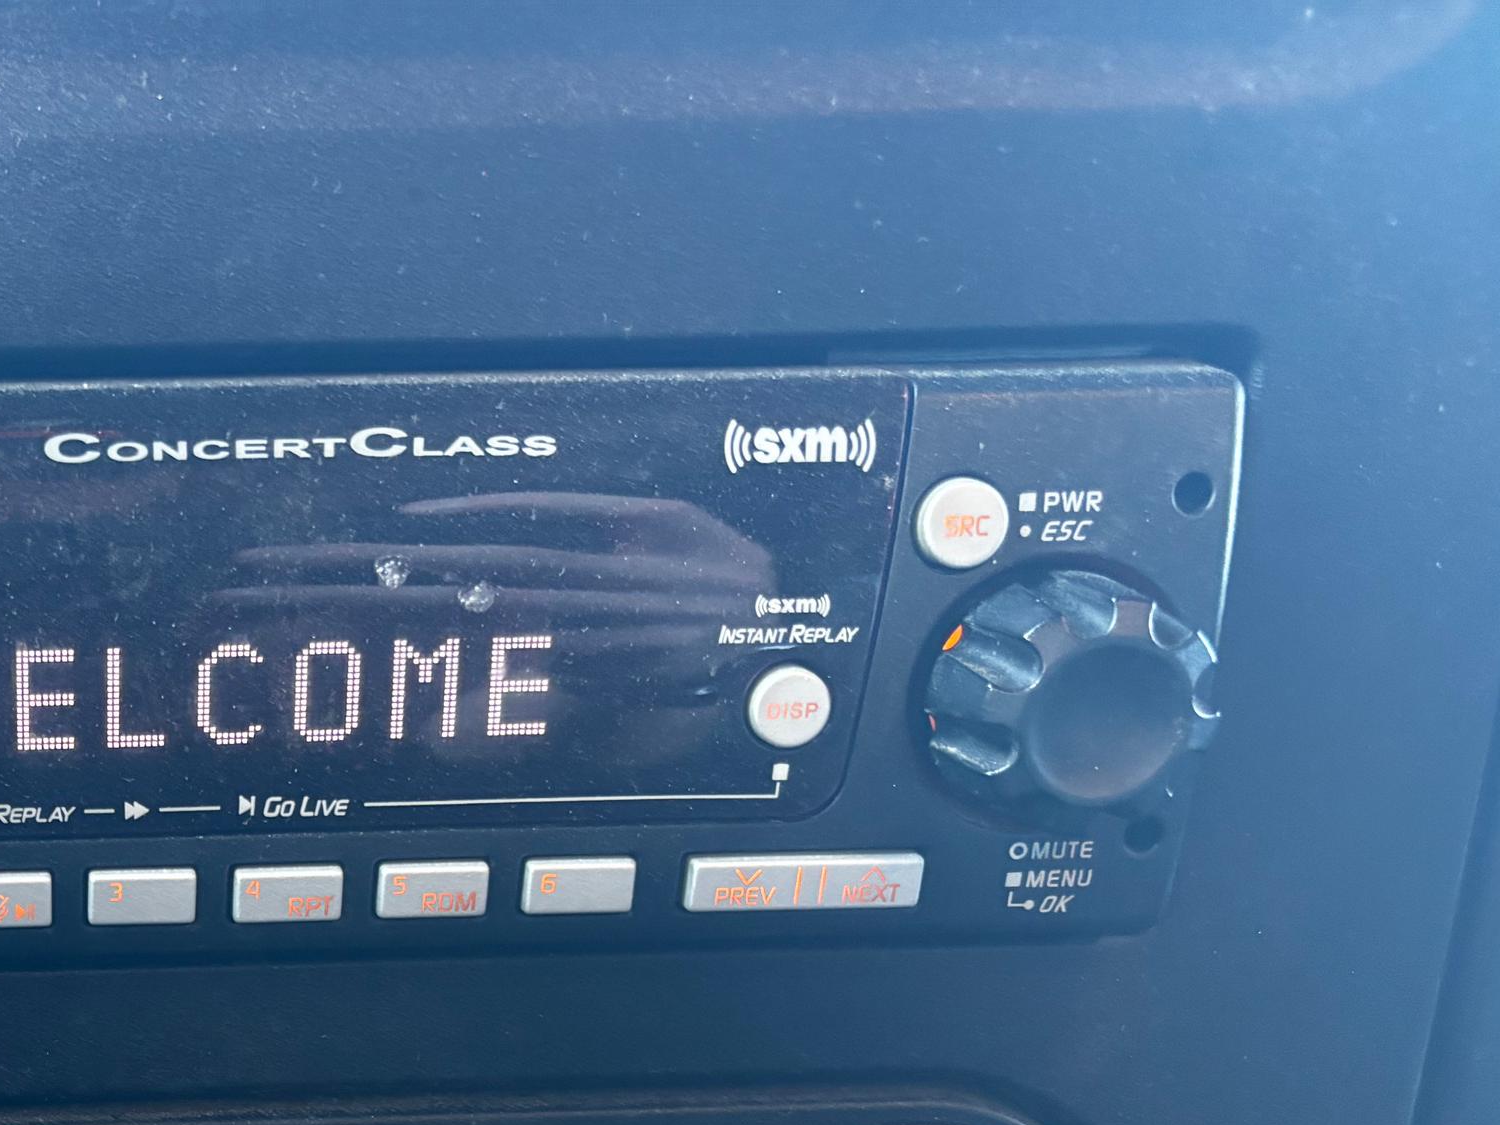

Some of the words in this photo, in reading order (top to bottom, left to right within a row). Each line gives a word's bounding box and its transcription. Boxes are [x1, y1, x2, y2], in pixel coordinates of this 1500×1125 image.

[1043, 490, 1102, 513] PWR
[944, 514, 989, 538] SRC
[1040, 519, 1092, 543] ESC
[15, 634, 553, 752] ELCOME
[766, 701, 820, 721] DISP
[1031, 841, 1095, 861] MUTE
[244, 879, 260, 899] 4
[392, 874, 407, 896] 5
[540, 872, 557, 894] 6
[1025, 868, 1094, 890] MENU
[108, 882, 124, 903] 3
[421, 891, 477, 912] RDM
[714, 885, 776, 906] PREV
[841, 883, 901, 904] NEXT
[288, 895, 334, 917] RPT
[1038, 894, 1071, 915] OK
